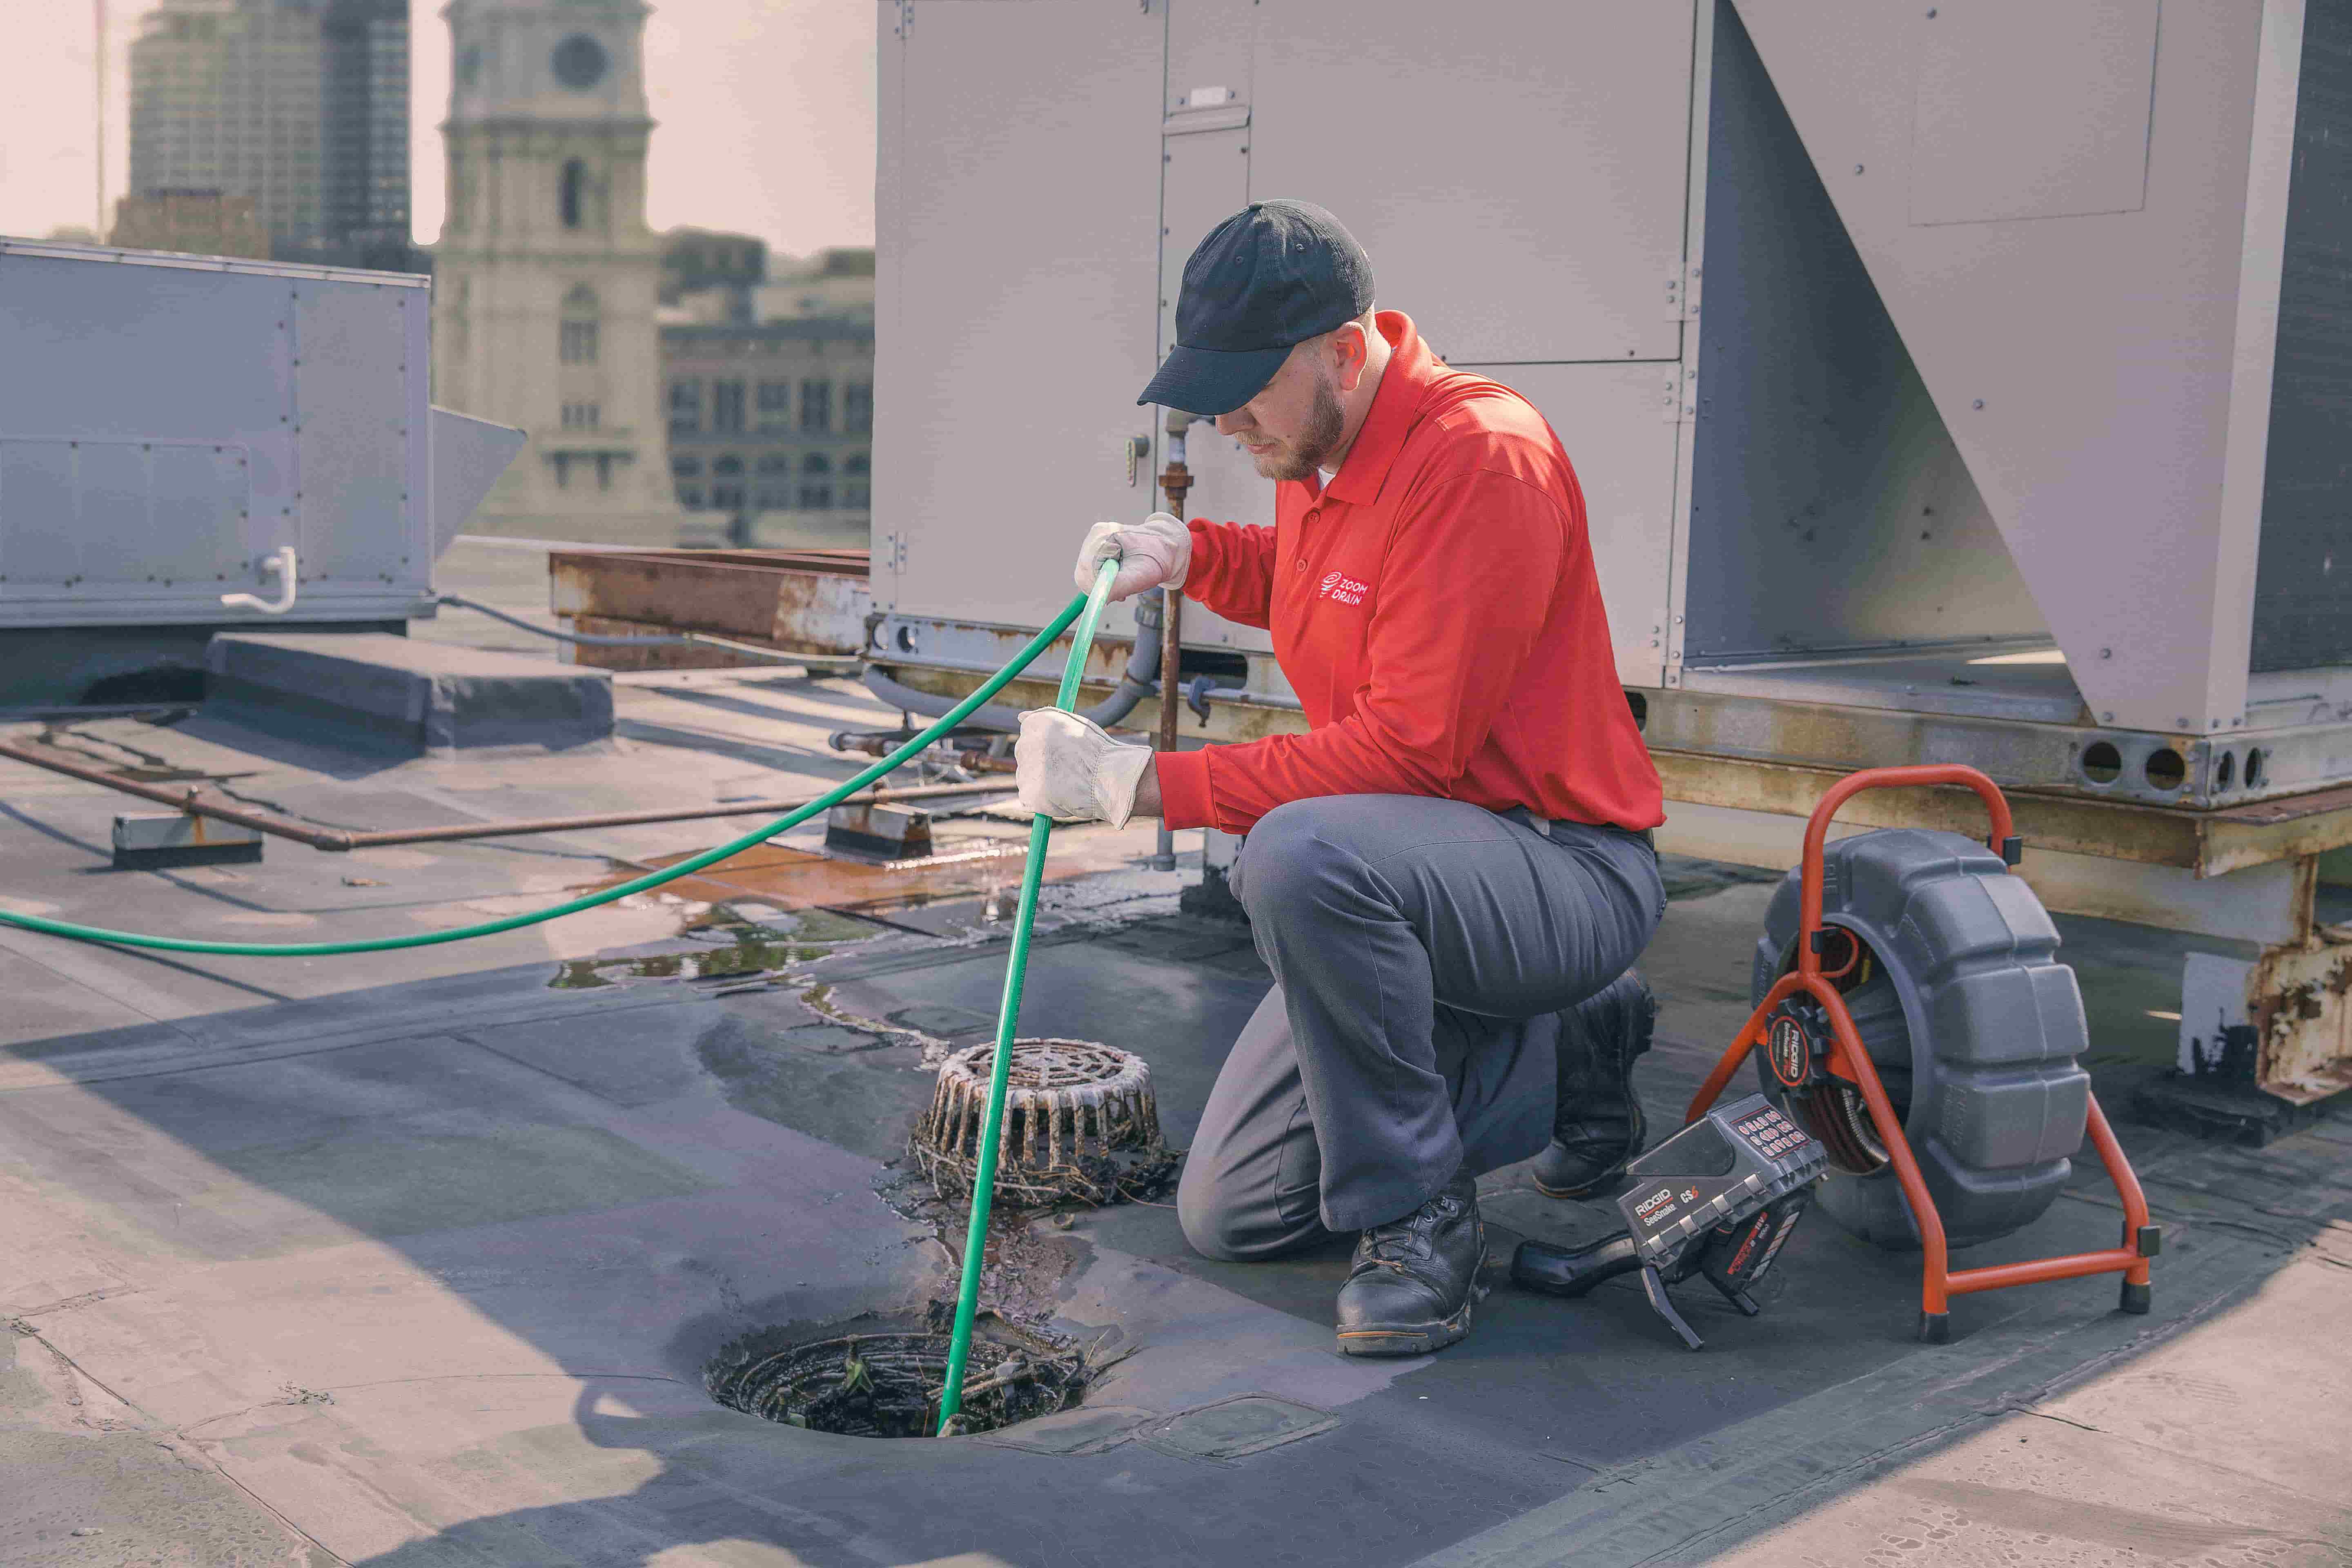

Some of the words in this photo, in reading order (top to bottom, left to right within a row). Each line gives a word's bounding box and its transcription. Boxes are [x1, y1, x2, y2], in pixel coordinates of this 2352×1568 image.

[1339, 579, 1368, 593] ZOOM
[1332, 589, 1362, 605] DRAIN
[1791, 1029, 1799, 1078] RIDGID
[1635, 1189, 1670, 1216] RIDGID
[1679, 1185, 1699, 1203] CS6
[1644, 1203, 1677, 1226] SeeSnake
